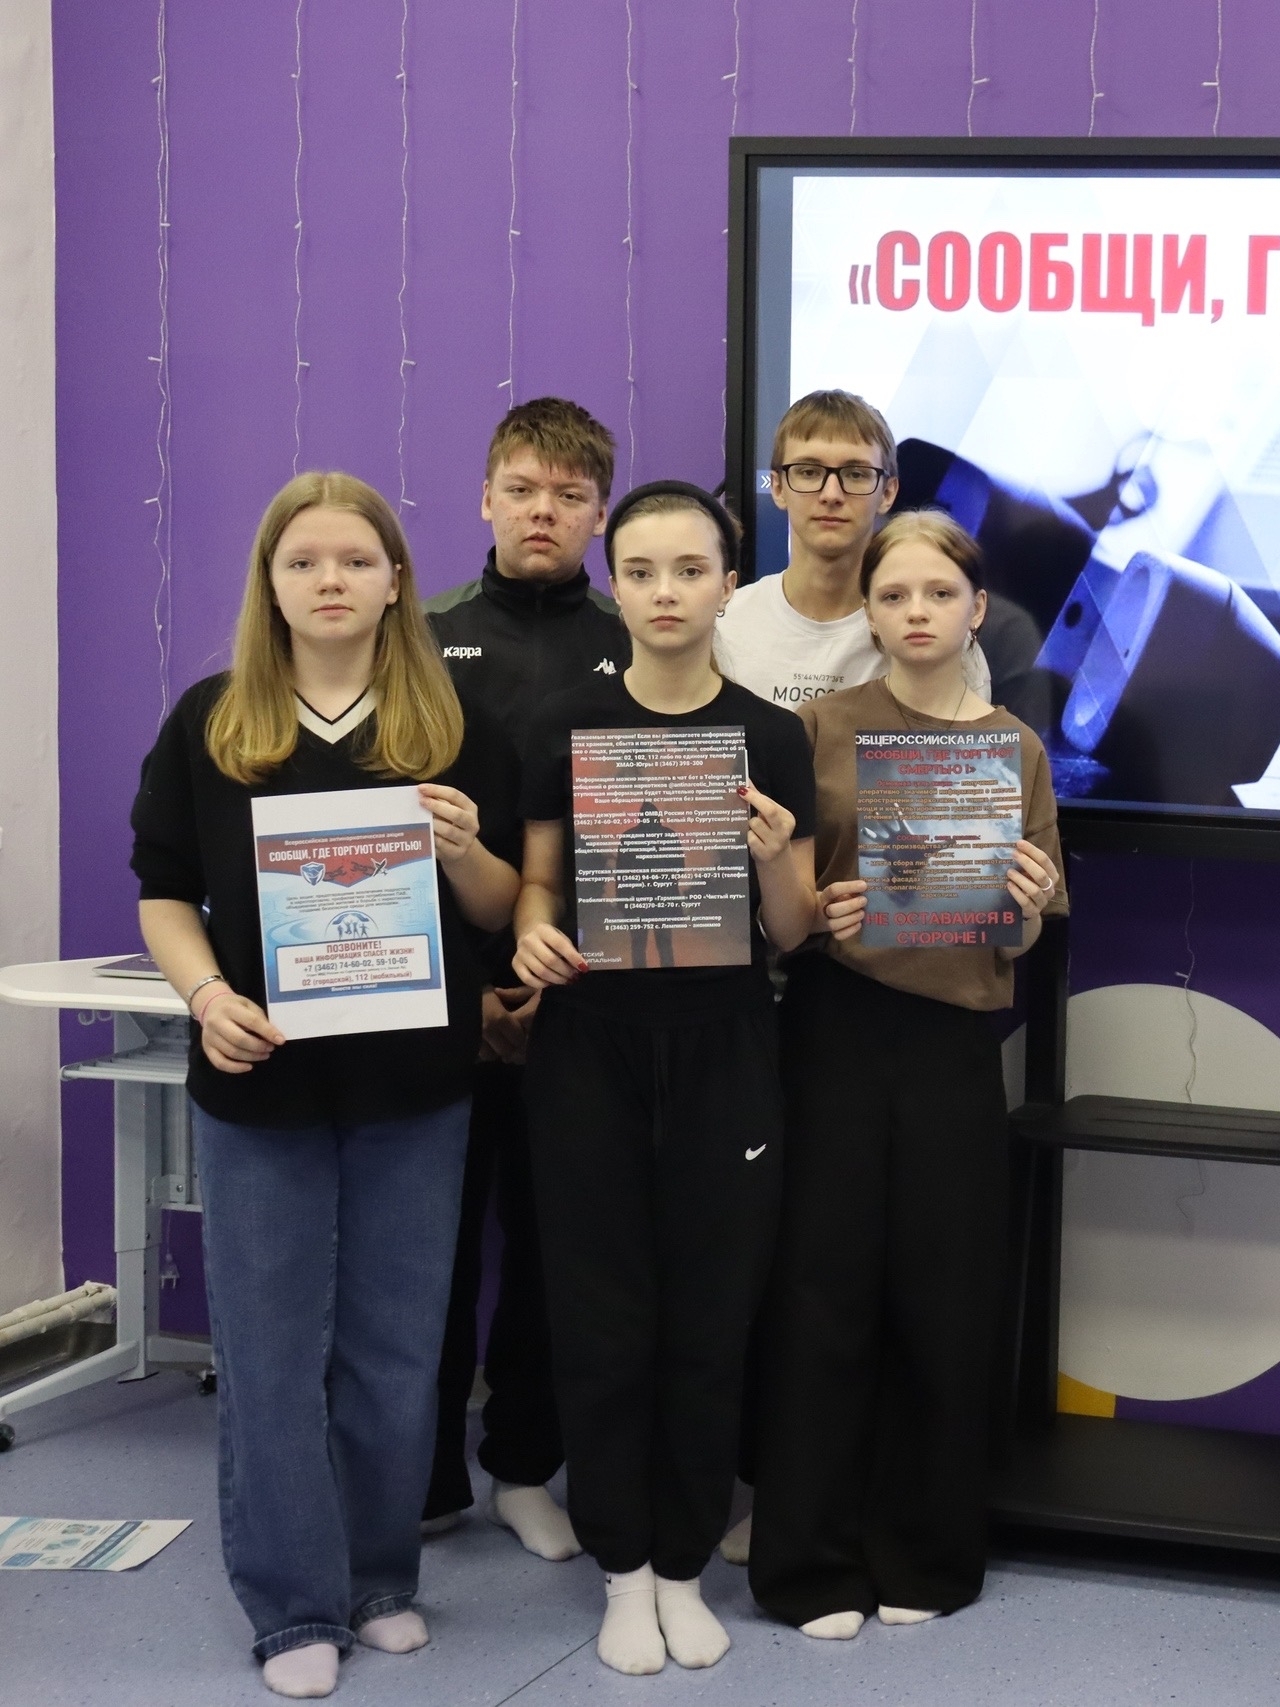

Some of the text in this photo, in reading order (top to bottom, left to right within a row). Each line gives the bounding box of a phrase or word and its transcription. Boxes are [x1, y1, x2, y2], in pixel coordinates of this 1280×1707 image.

[849, 231, 1222, 325] «СООБЩИ,
[443, 646, 482, 659] Kappa
[773, 686, 836, 702] MOSC
[977, 732, 1020, 745] АКЦИЯ
[926, 749, 951, 762] ГДЕ
[953, 746, 1015, 760] ТОРГУЮТ
[897, 763, 963, 775] СМЕРТЬЮ
[269, 840, 422, 862] СООБЩИ, ГДЕ ТОРГУЮТ СМЕРТЬЮ!
[866, 912, 889, 926] НЕ
[1002, 911, 1015, 925] В
[896, 931, 977, 944] СТОРОНЕ
[326, 940, 381, 953] ПОЗВОНИТЕ!
[295, 956, 314, 964] ВАША
[316, 951, 361, 961] ИНФОРМАЦИЯ
[355, 973, 368, 981] 112
